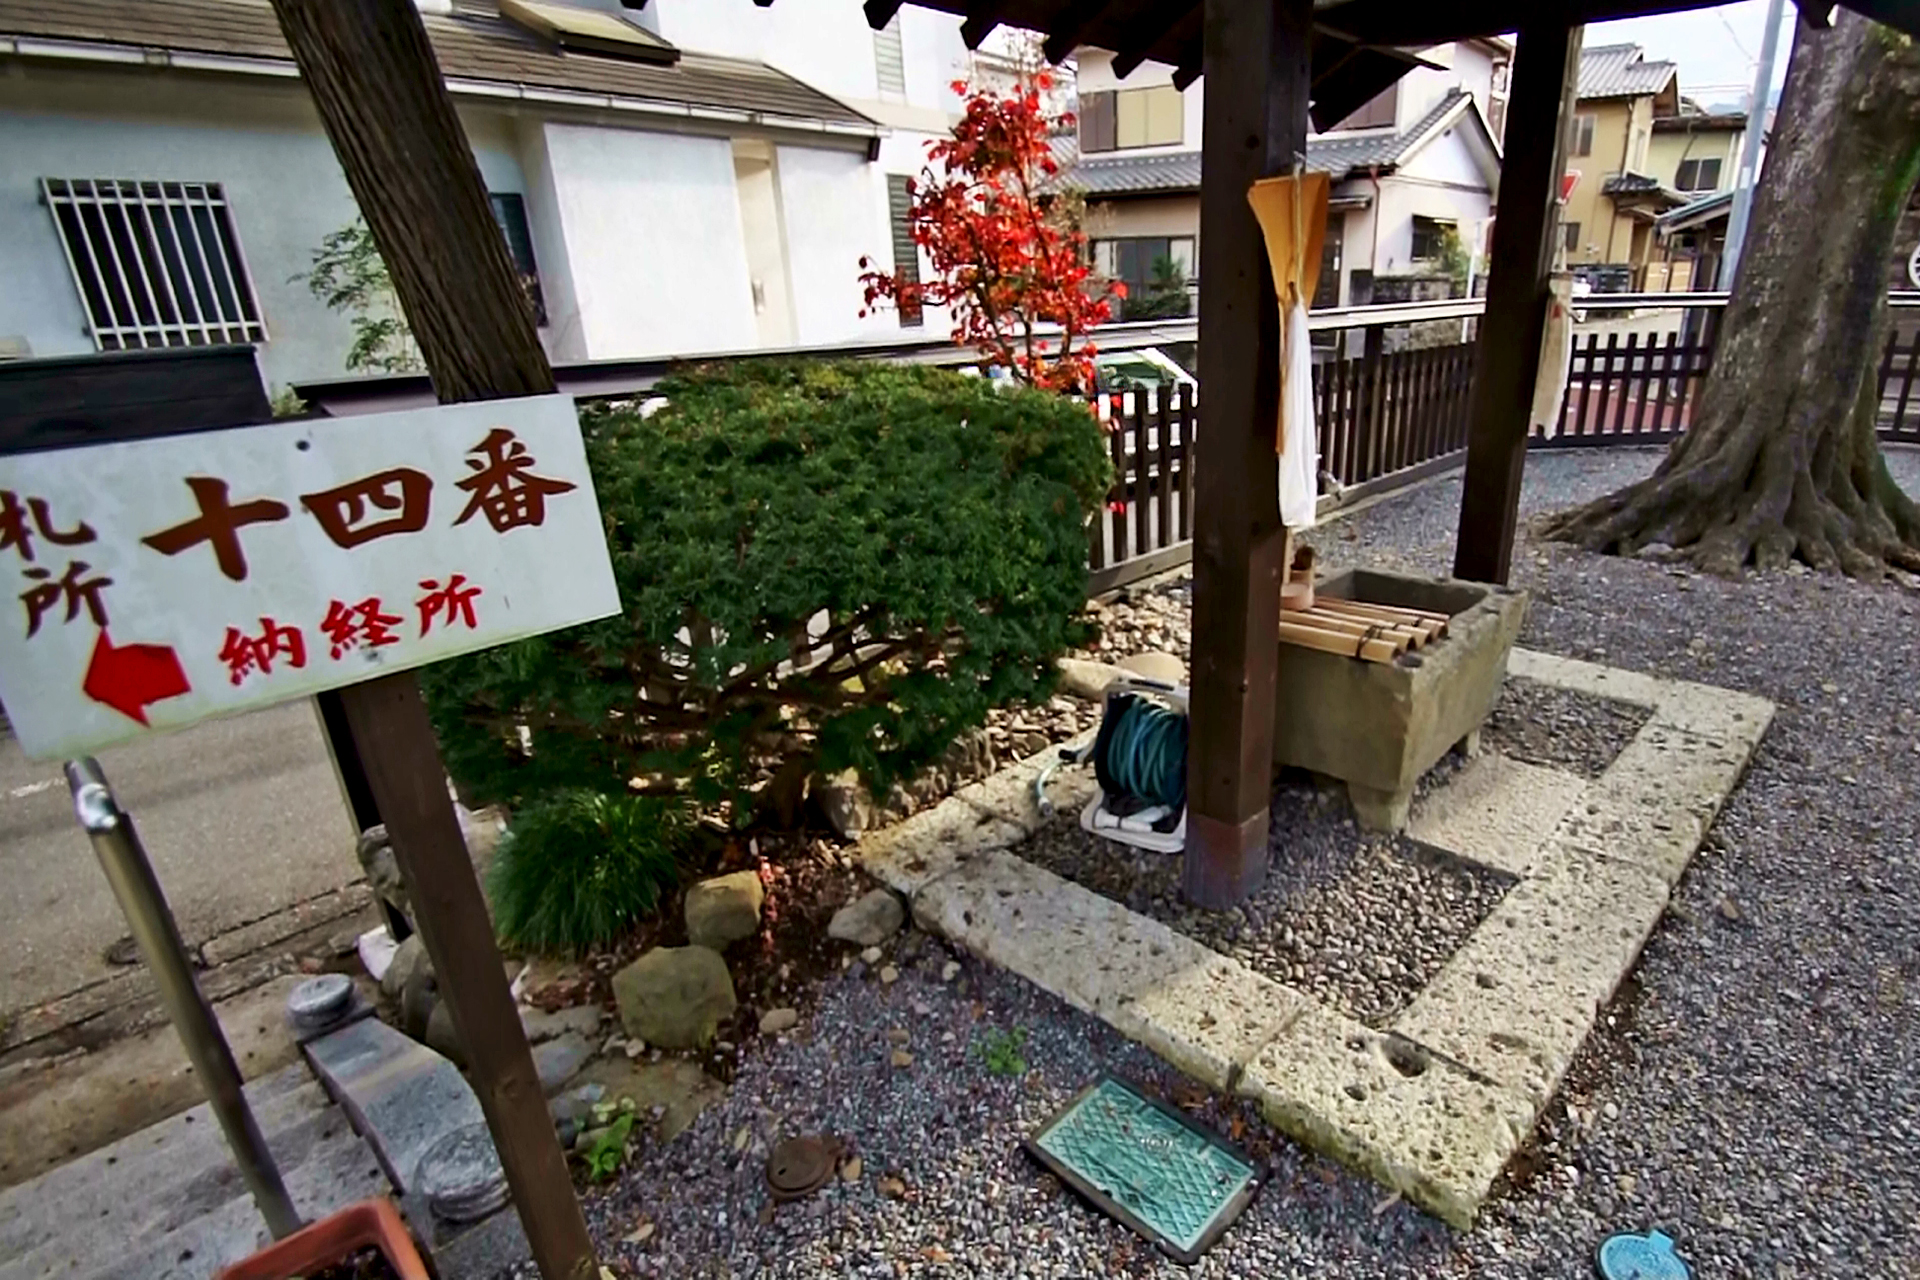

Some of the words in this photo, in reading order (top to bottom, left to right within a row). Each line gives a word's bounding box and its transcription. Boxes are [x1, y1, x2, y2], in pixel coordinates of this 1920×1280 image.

[0, 489, 114, 640] 札所
[141, 428, 577, 582] 十四番
[218, 575, 483, 686] 納経所
